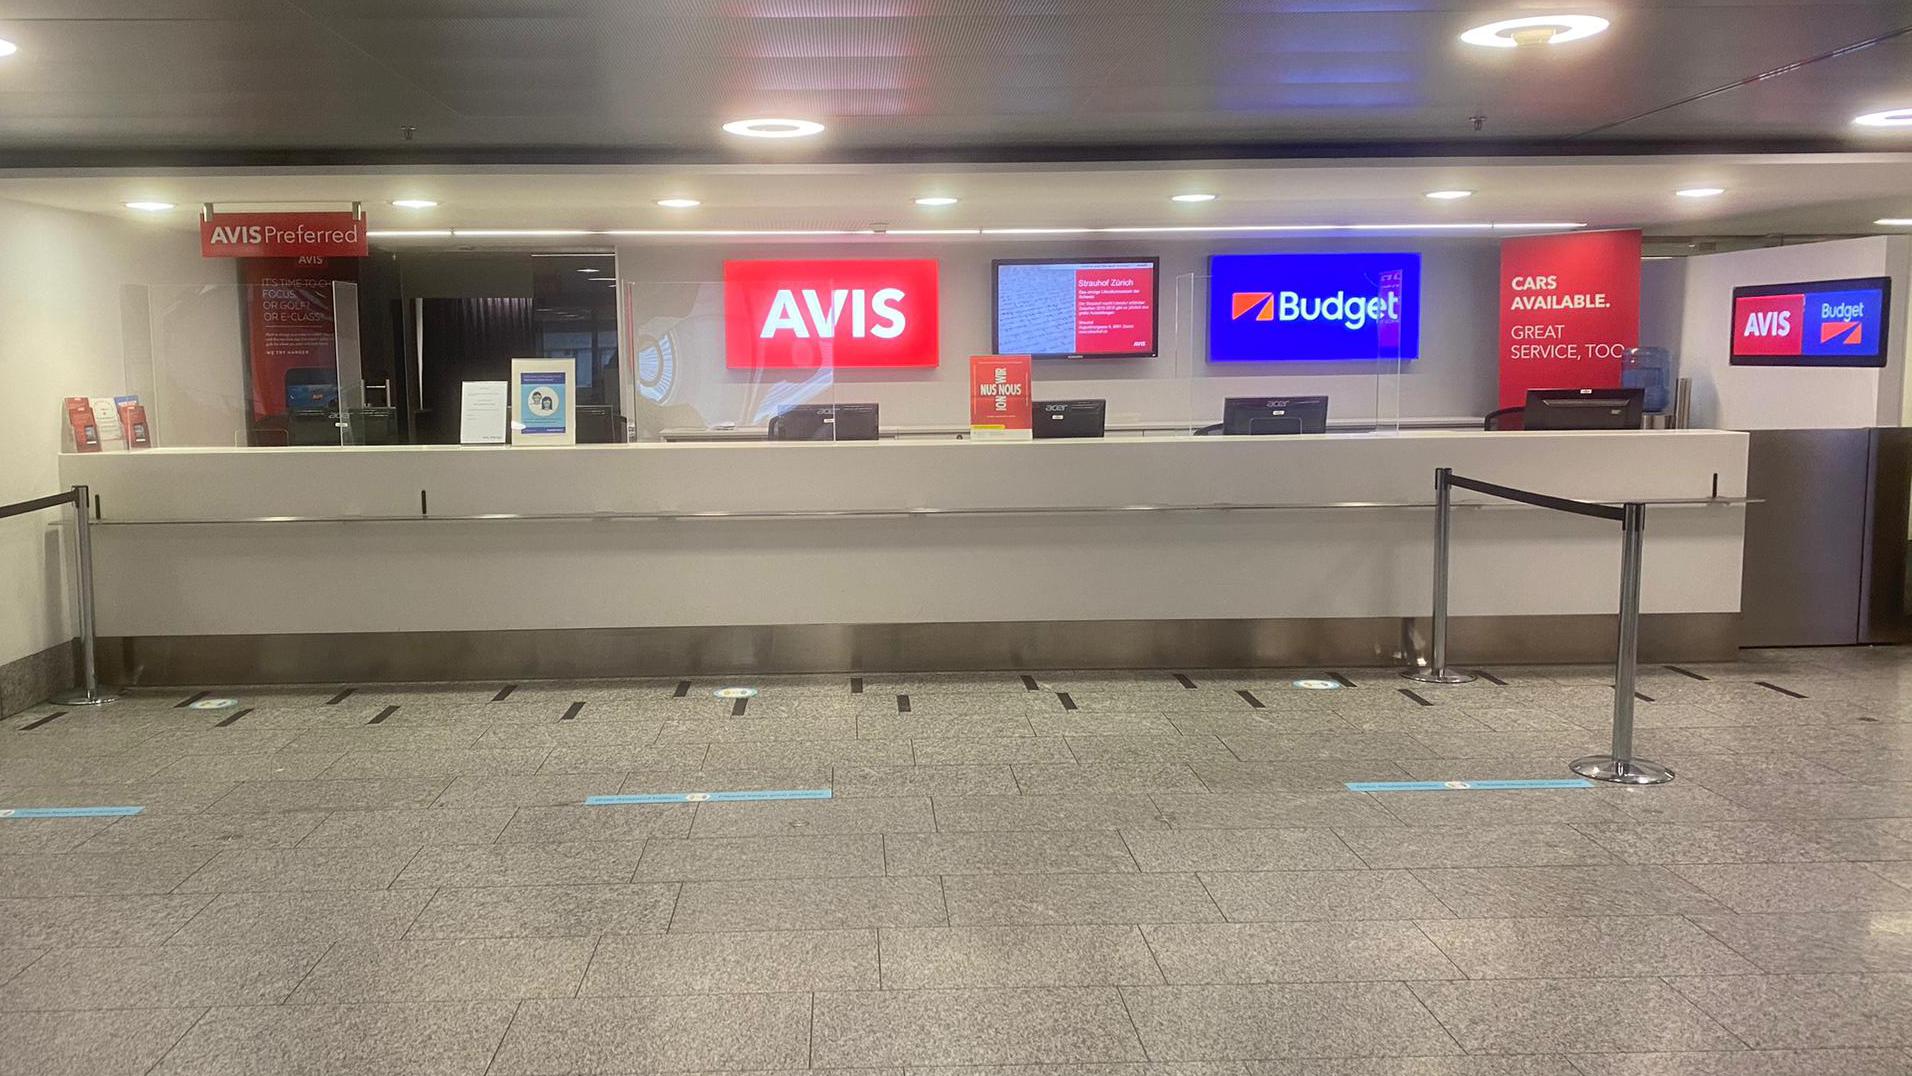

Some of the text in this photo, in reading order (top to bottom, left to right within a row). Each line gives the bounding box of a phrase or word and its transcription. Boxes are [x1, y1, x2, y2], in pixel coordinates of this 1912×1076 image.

[210, 224, 358, 244] AVIS Preferred
[299, 256, 323, 265] AVIS
[1078, 279, 1109, 287] Strauhof
[1511, 275, 1557, 290] CARS
[262, 301, 278, 310] OR
[1511, 294, 1611, 310] AVAILABLE.
[263, 312, 279, 321] OR
[760, 288, 906, 339] AVIS
[1279, 291, 1399, 330] Budget
[1821, 302, 1865, 323] Budget
[1743, 310, 1792, 337] AVIS
[1511, 325, 1565, 339] GREAT
[1511, 344, 1581, 361] SERVICE,
[980, 383, 1022, 396] NUS NOUS
[1045, 404, 1068, 412] acer
